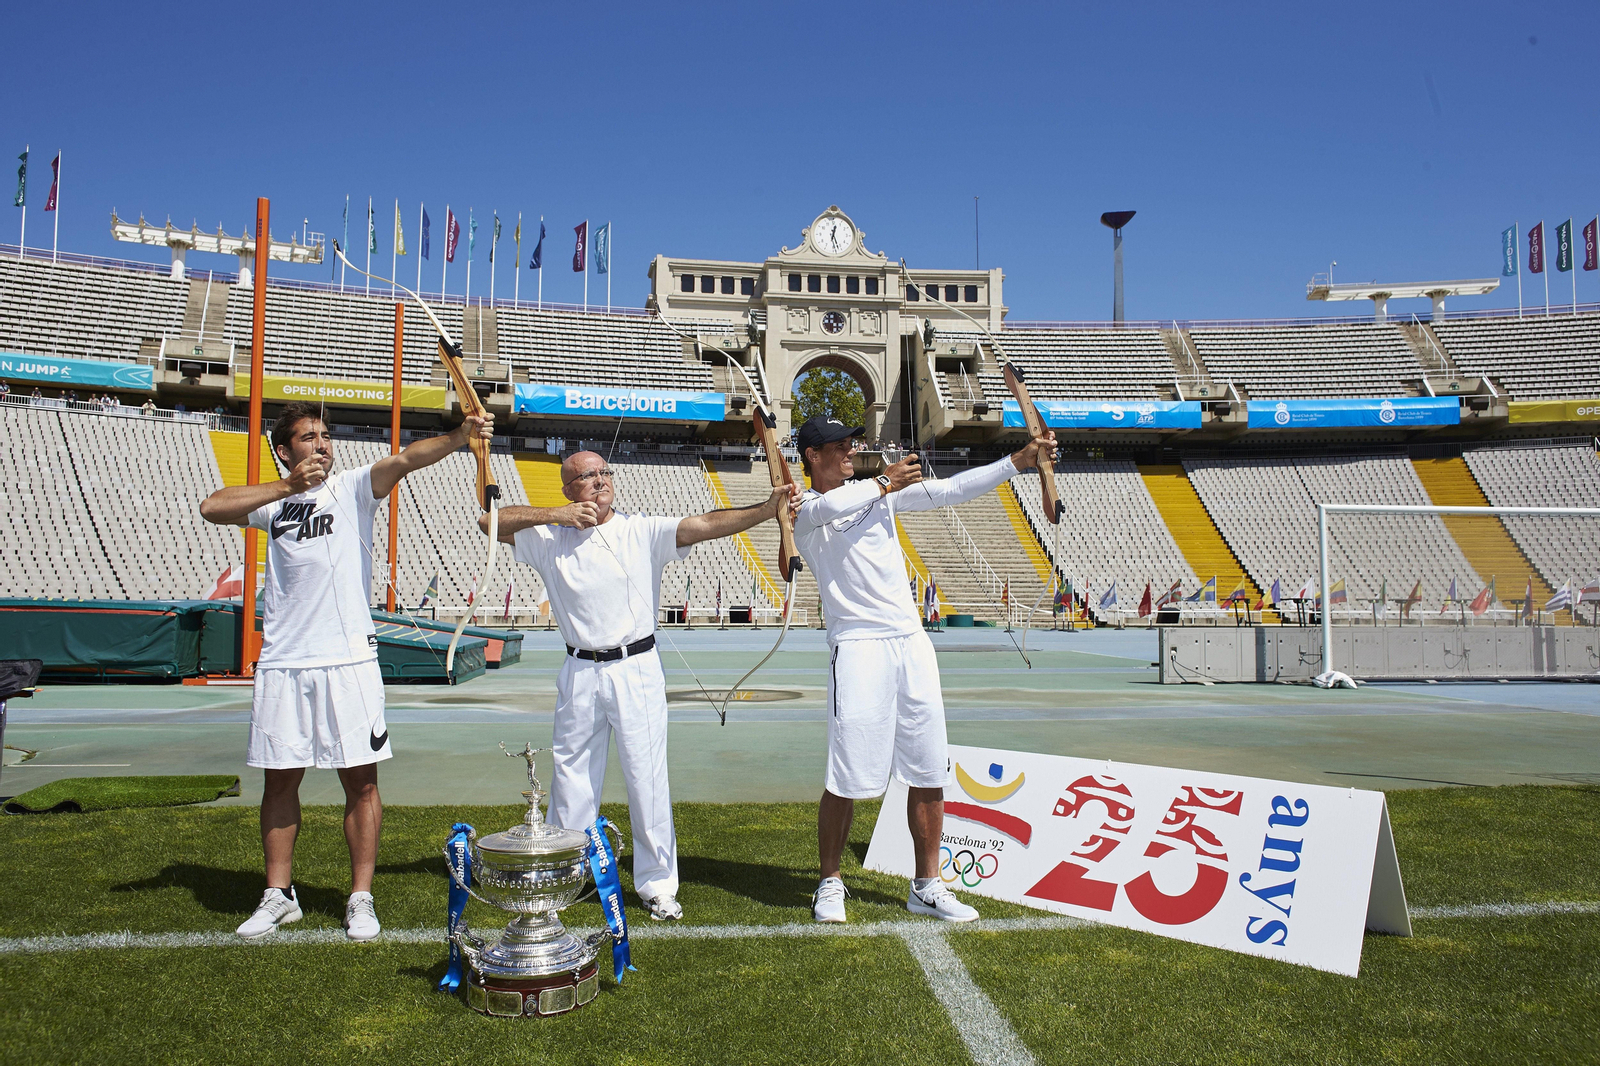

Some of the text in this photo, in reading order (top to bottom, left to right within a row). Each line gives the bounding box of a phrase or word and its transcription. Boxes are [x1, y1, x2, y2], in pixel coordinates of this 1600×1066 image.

[16, 363, 59, 375] JUMP
[282, 385, 385, 400] OPEN SHOOTING
[565, 389, 677, 413] Barcelona
[296, 513, 334, 541] AIR
[940, 831, 987, 849] Barcelona
[1024, 775, 1244, 925] 25
[454, 841, 465, 882] abadell
[1239, 795, 1310, 947] anys
